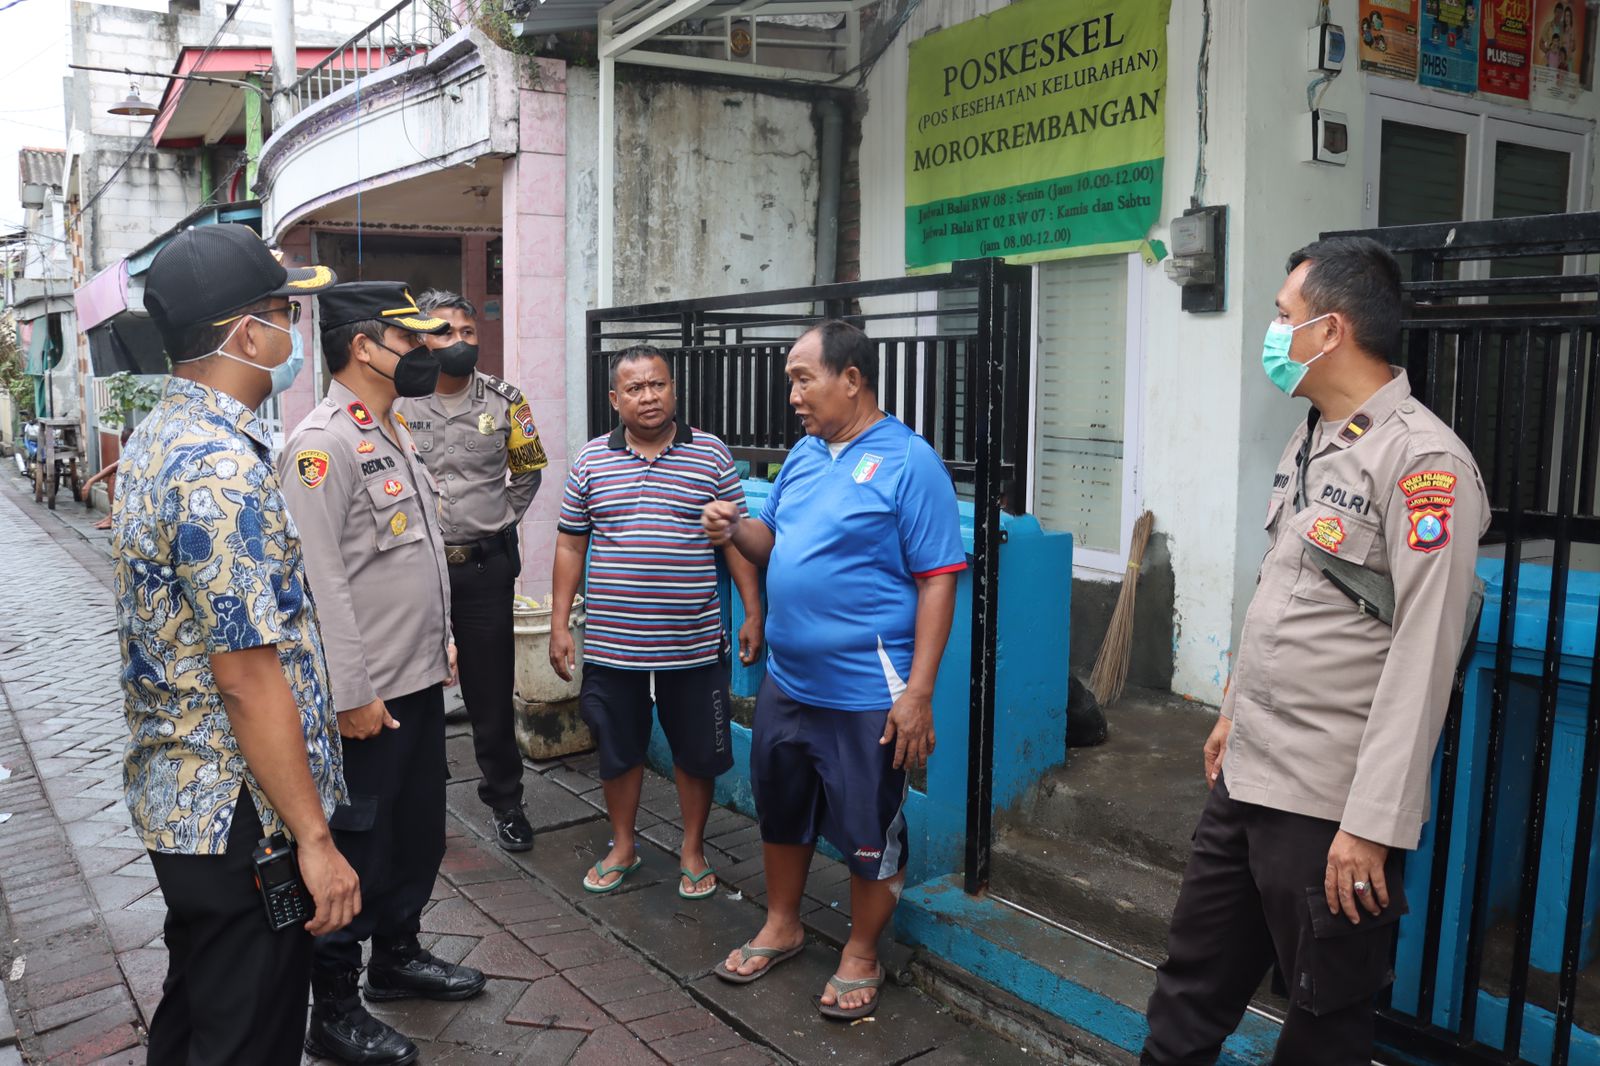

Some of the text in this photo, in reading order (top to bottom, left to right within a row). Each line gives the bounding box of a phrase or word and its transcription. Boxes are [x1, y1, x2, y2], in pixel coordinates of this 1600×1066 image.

[943, 13, 1124, 97] POSKESKEL
[1422, 54, 1447, 77] PHBS
[1487, 48, 1507, 64] PLUS
[918, 50, 1158, 134] (POS KESEHATAN KELURAHAN)
[913, 89, 1161, 172] MOROKREMBANGAN
[918, 203, 944, 224] Jadwal
[947, 200, 970, 217] Balai
[971, 195, 990, 210] RW
[993, 194, 1006, 208] 08
[1016, 189, 1044, 204] Senin
[1076, 165, 1154, 191] 10.00-12.00)
[922, 222, 947, 244] Jadwal
[951, 220, 974, 236] Balai
[976, 216, 991, 231] RT
[993, 214, 1007, 228] 02
[1009, 211, 1028, 226] RW
[1031, 209, 1046, 223] 07
[1056, 202, 1089, 217] Kamis
[1092, 197, 1114, 213] dan
[1117, 194, 1151, 210] Sabtu
[980, 228, 1071, 256] (jam 08.00-12.00)
[1320, 484, 1372, 516] POLRI
[1410, 496, 1451, 506] JAWA TIMUR
[711, 689, 725, 753] COOLEST
